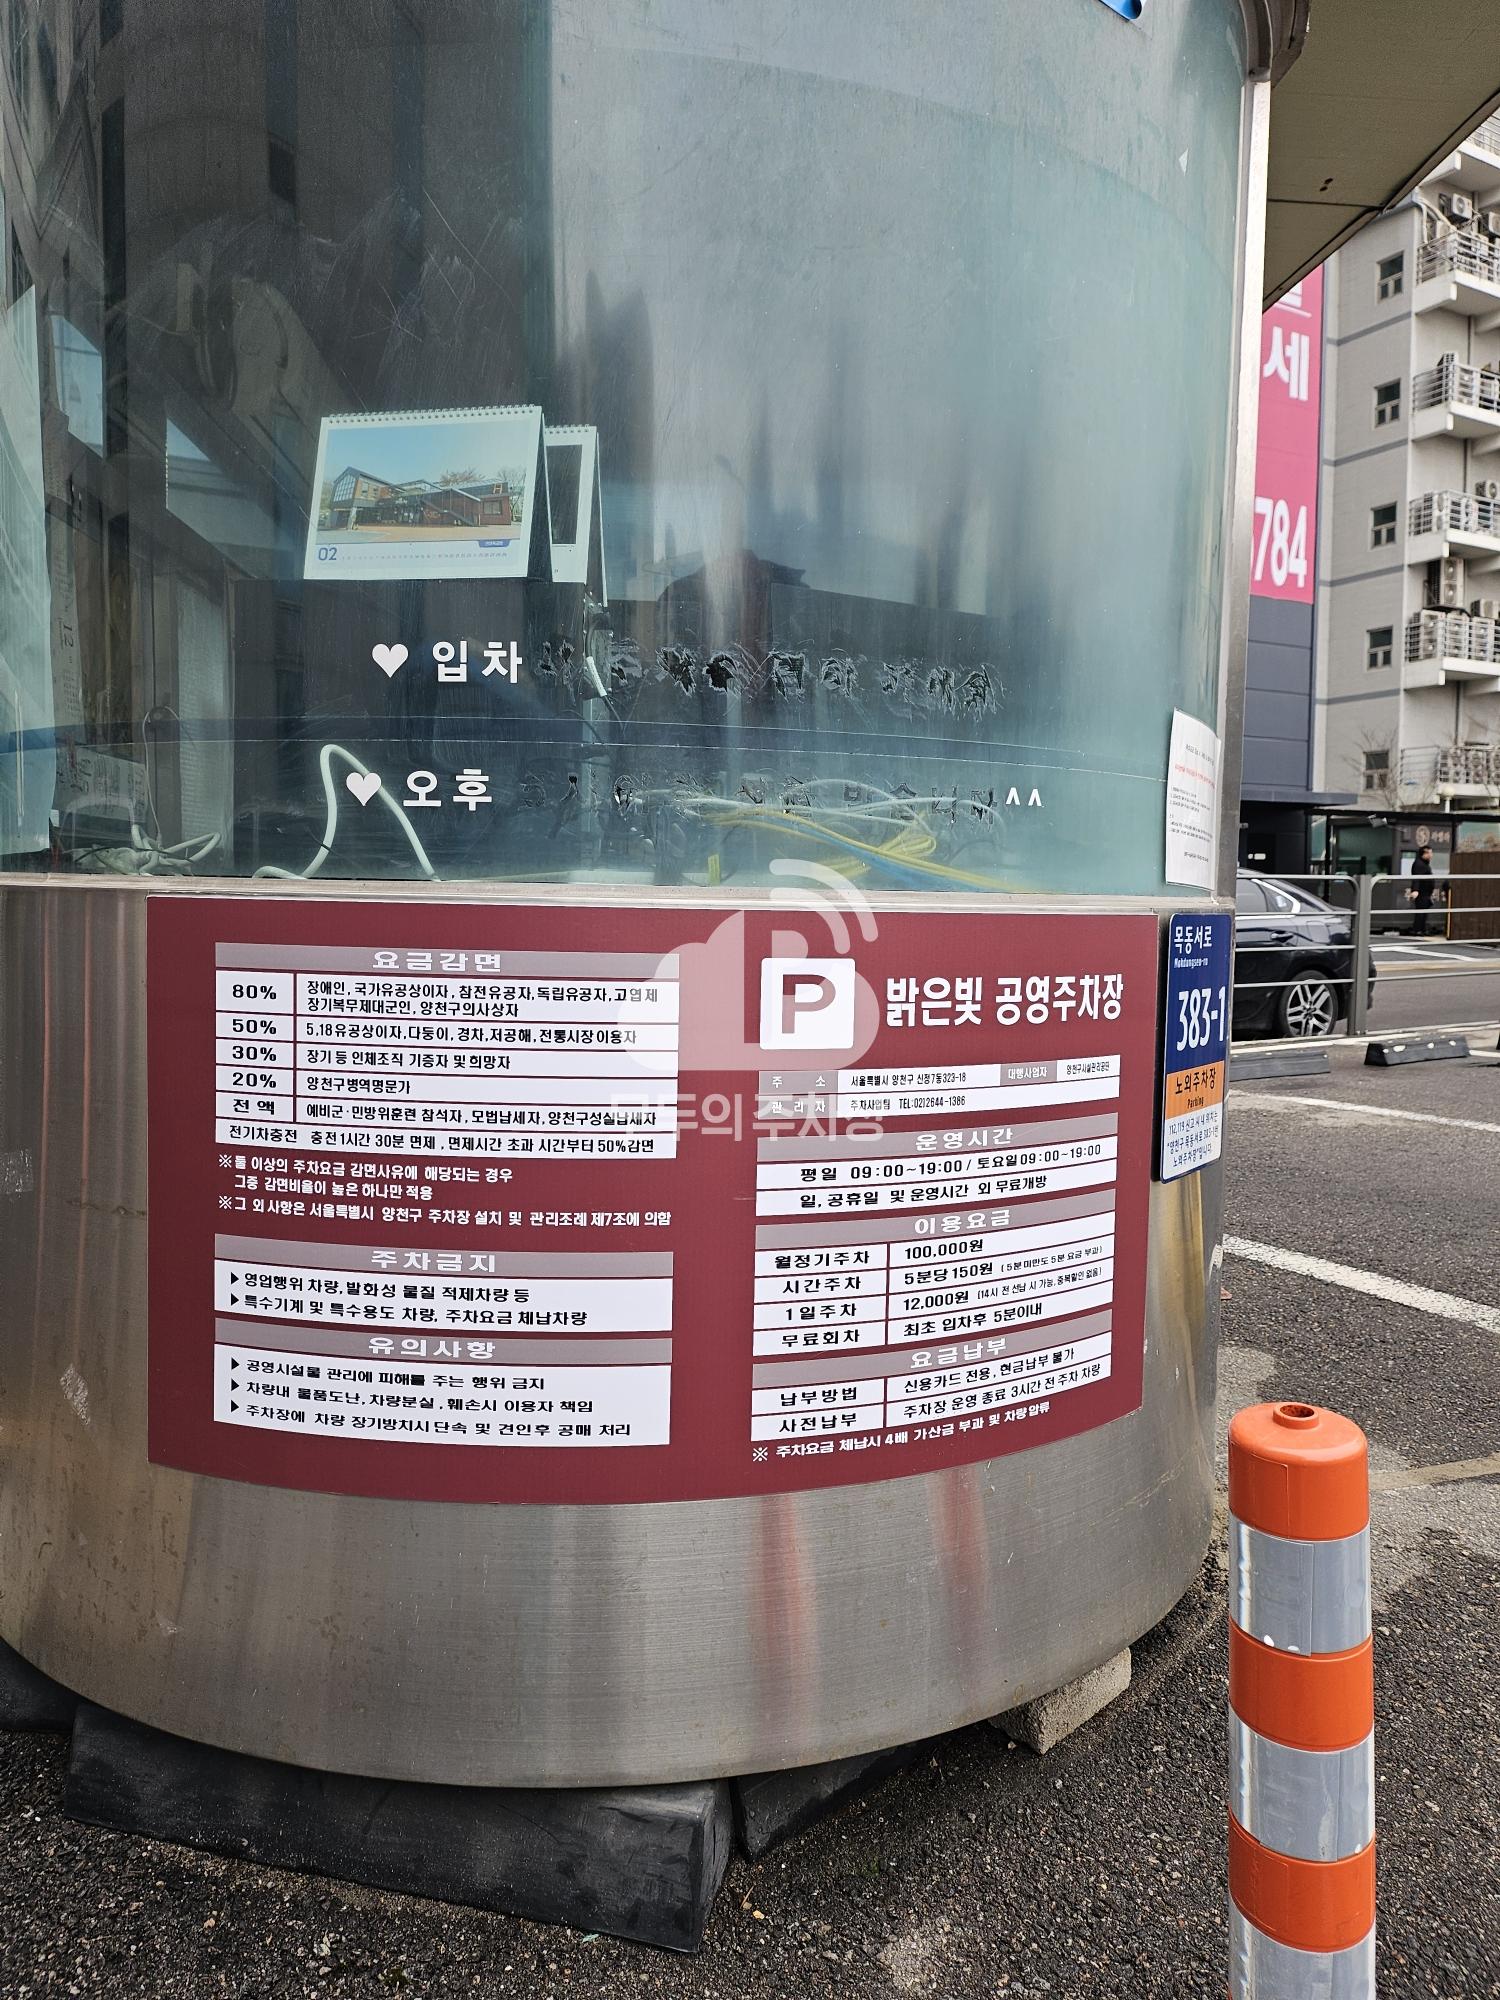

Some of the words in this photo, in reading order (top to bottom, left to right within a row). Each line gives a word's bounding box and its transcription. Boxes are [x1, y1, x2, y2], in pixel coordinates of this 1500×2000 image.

[318, 547, 337, 561] 02
[1251, 495, 1308, 588] 784
[402, 768, 493, 811] 오후
[1174, 926, 1212, 954] 목동서로
[372, 951, 501, 973] 요금감면
[232, 984, 277, 1000] 80%
[886, 977, 982, 1027] 밝은빛
[995, 973, 1124, 1026] 공영주차장
[420, 1000, 519, 1017] 양천구의사상자
[1176, 986, 1226, 1051] 383-1
[232, 1019, 277, 1034] 50%
[232, 1045, 277, 1061] 30%
[307, 1050, 332, 1064] 장기
[335, 1051, 347, 1065] 등
[352, 1052, 403, 1066] 인체조직
[409, 1052, 448, 1069] 기증자
[469, 1055, 510, 1069] 희망자
[232, 1072, 277, 1088] 20%
[851, 1075, 889, 1087] 서울특별시
[892, 1074, 914, 1086] 양천구
[1008, 1067, 1047, 1080] 대행사업자
[1175, 1067, 1216, 1094] 노외주차장
[1187, 1097, 1204, 1109] Parking
[421, 1108, 469, 1124] 참석자,
[229, 1125, 297, 1143] 전기차충전
[375, 1134, 404, 1148] 30분
[449, 1137, 502, 1152] 면제시간
[507, 1139, 534, 1152] 초과
[539, 1139, 594, 1153] 시간부터
[915, 1127, 1014, 1151] 운영시간
[251, 1156, 288, 1173] 이상의
[293, 1159, 345, 1177] 주차요금
[351, 1162, 417, 1181] 감면사유에
[424, 1166, 480, 1183] 해당되는
[485, 1168, 512, 1184] 경우
[235, 1175, 258, 1190] 그중
[264, 1177, 326, 1195] 감면비율이
[332, 1181, 358, 1197] 높은
[362, 1183, 402, 1199] 하나만
[406, 1185, 433, 1201] 적용
[827, 1191, 879, 1207] 공휴일
[891, 1190, 904, 1203] 및
[911, 1184, 969, 1201] 운영시간
[978, 1182, 991, 1195] 외
[996, 1175, 1047, 1193] 무료개방
[268, 1200, 305, 1216] 사항은
[310, 1203, 374, 1220] 서울특별시
[382, 1206, 422, 1223] 양천구
[428, 1208, 470, 1225] 주차장
[474, 1211, 502, 1225] 설치
[509, 1212, 522, 1226] 및
[530, 1212, 587, 1227] 관리조례
[591, 1212, 639, 1227] 제7조에
[644, 1212, 671, 1227] 의함
[914, 1209, 1010, 1234] 이용요금
[371, 1250, 496, 1273] 주차금지
[775, 1251, 869, 1269] 월정기주차
[783, 1276, 861, 1294] 시간주차
[905, 1270, 948, 1285] 5분당
[953, 1262, 993, 1279] 150원
[244, 1273, 303, 1291] 영업행위
[403, 1285, 435, 1300] 물질
[513, 1289, 530, 1303] 등
[244, 1295, 303, 1313] 특수기계
[310, 1301, 323, 1315] 및
[330, 1302, 395, 1320] 특수용도
[402, 1307, 438, 1322] 차량,
[446, 1309, 512, 1325] 주차요금
[518, 1311, 587, 1326] 체납차량
[904, 1321, 935, 1336] 최초
[943, 1313, 987, 1331] 입차후
[994, 1302, 1043, 1323] 5분이내
[368, 1337, 496, 1359] 유의사항
[782, 1329, 860, 1347] 무료회차
[910, 1337, 1007, 1369] 요금납부
[246, 1360, 321, 1379] 공영시설물
[327, 1368, 372, 1383] 관리에
[378, 1372, 425, 1386] 피해를
[432, 1375, 464, 1388] 주는
[472, 1376, 505, 1390] 행위
[512, 1377, 545, 1390] 금지
[905, 1374, 961, 1393] 신용카드
[1000, 1354, 1048, 1377] 현금납부
[1052, 1348, 1074, 1363] 불가
[246, 1382, 290, 1398] 차량내
[504, 1400, 553, 1412] 이용자
[560, 1401, 593, 1412] 책임
[780, 1387, 857, 1407] 납부방법
[904, 1401, 946, 1418] 주차장
[951, 1394, 977, 1410] 운영
[982, 1389, 1006, 1405] 종료
[1011, 1380, 1041, 1398] 3시간
[1045, 1378, 1055, 1390] 전
[1081, 1363, 1100, 1379] 차량
[246, 1405, 305, 1423] 주차장에
[315, 1413, 345, 1426] 차량
[351, 1416, 429, 1433] 장기방치시
[434, 1421, 467, 1435] 단속
[475, 1423, 490, 1436] 및
[499, 1423, 550, 1437] 견인후
[558, 1424, 591, 1437] 공매
[599, 1424, 631, 1437] 처리
[779, 1413, 856, 1433] 사전납부
[776, 1441, 834, 1457] 주차요금
[839, 1435, 881, 1452] 체납시
[885, 1431, 908, 1445] 4배
[914, 1424, 954, 1441] 가산금
[959, 1418, 984, 1432] 부과
[989, 1414, 1000, 1425] 및
